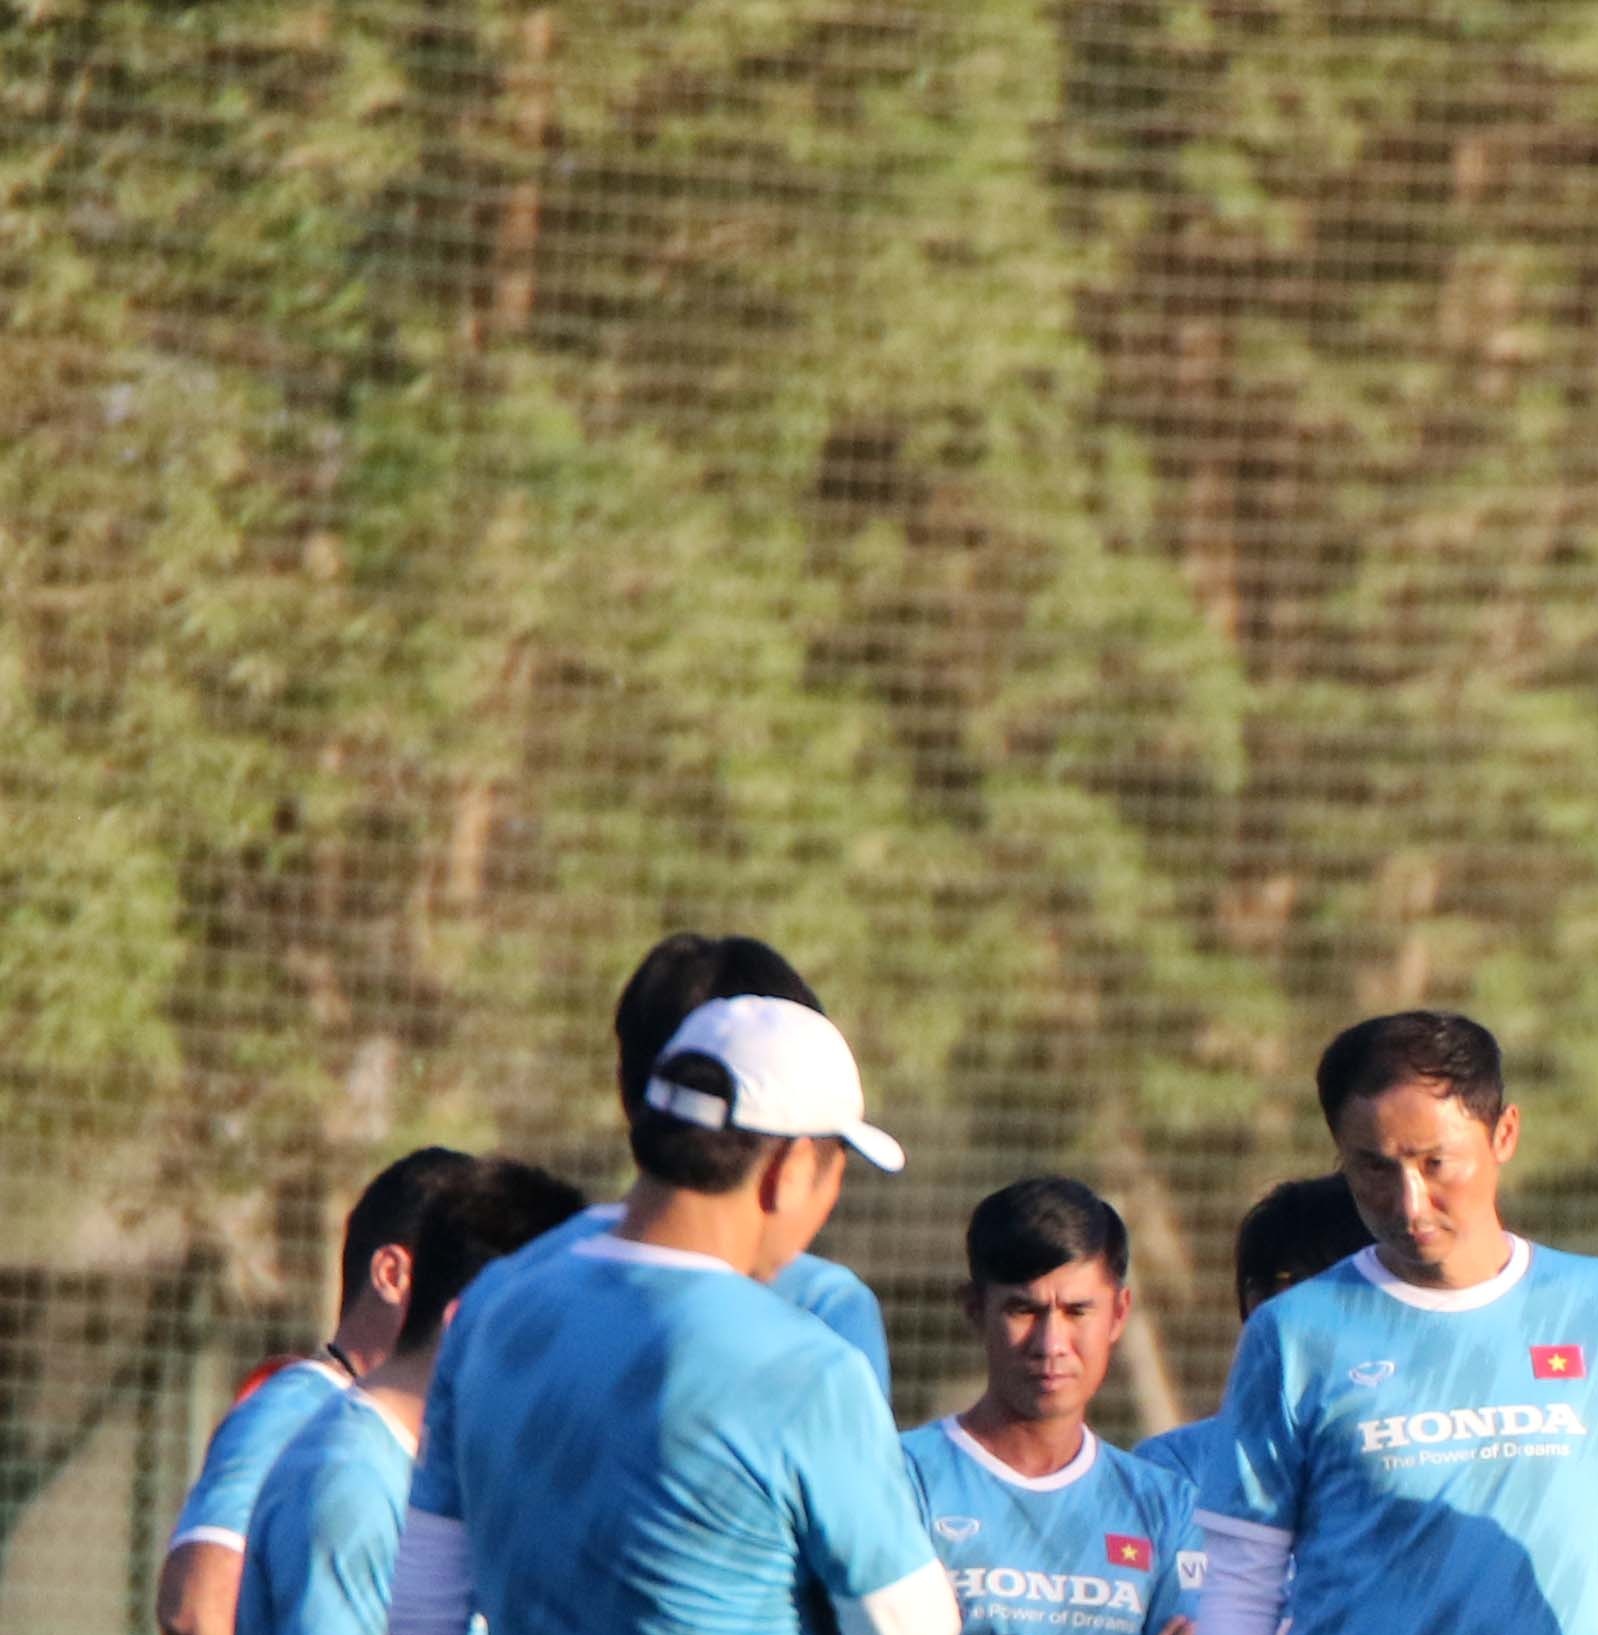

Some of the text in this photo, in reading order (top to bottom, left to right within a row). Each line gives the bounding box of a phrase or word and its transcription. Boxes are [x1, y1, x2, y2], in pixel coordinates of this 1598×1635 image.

[1357, 1402, 1588, 1453] HONDA
[1382, 1440, 1573, 1472] The Power of Deams
[952, 1566, 1146, 1618] HONDA
[988, 1604, 1045, 1622] Power
[1049, 1610, 1069, 1625] of
